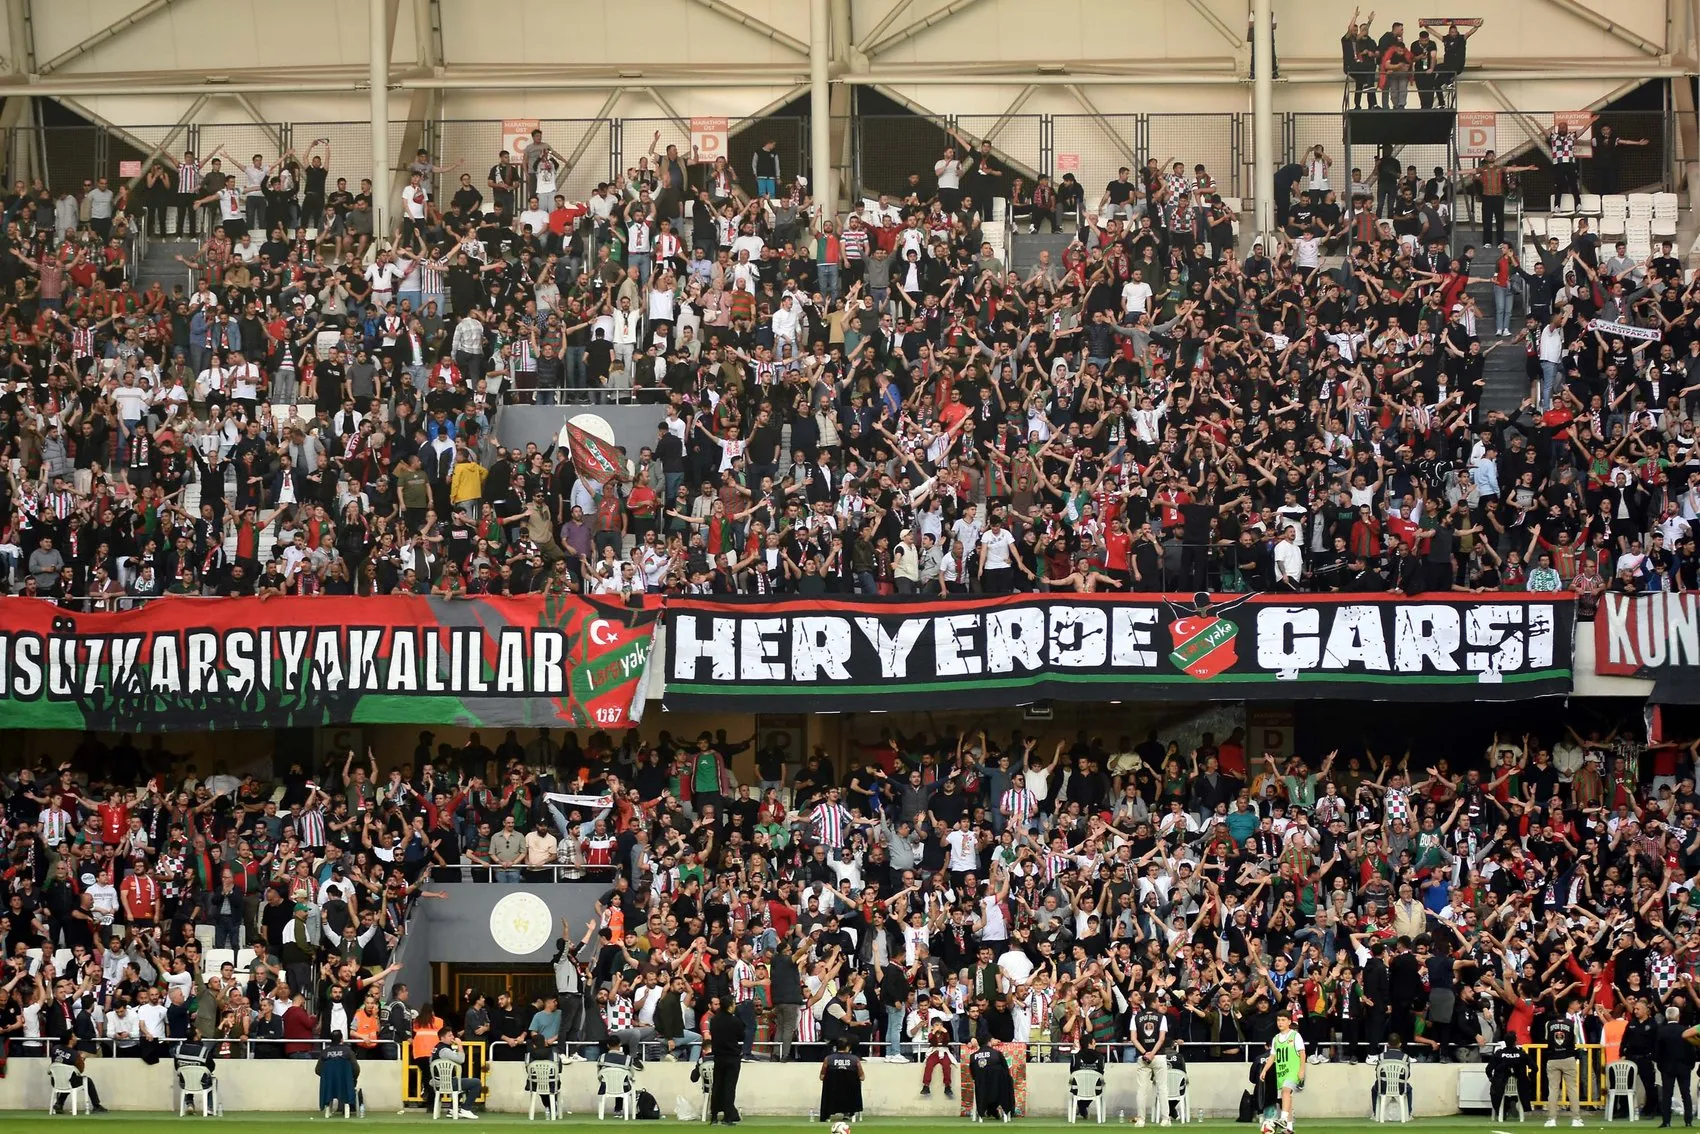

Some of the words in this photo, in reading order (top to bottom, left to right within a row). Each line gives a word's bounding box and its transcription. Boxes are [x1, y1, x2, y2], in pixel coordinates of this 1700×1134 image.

[513, 136, 529, 154] C
[701, 135, 719, 151] D
[1469, 129, 1487, 146] D
[674, 606, 1159, 681] HERYERDE
[1264, 730, 1284, 749] D
[974, 1051, 990, 1060] POLIS
